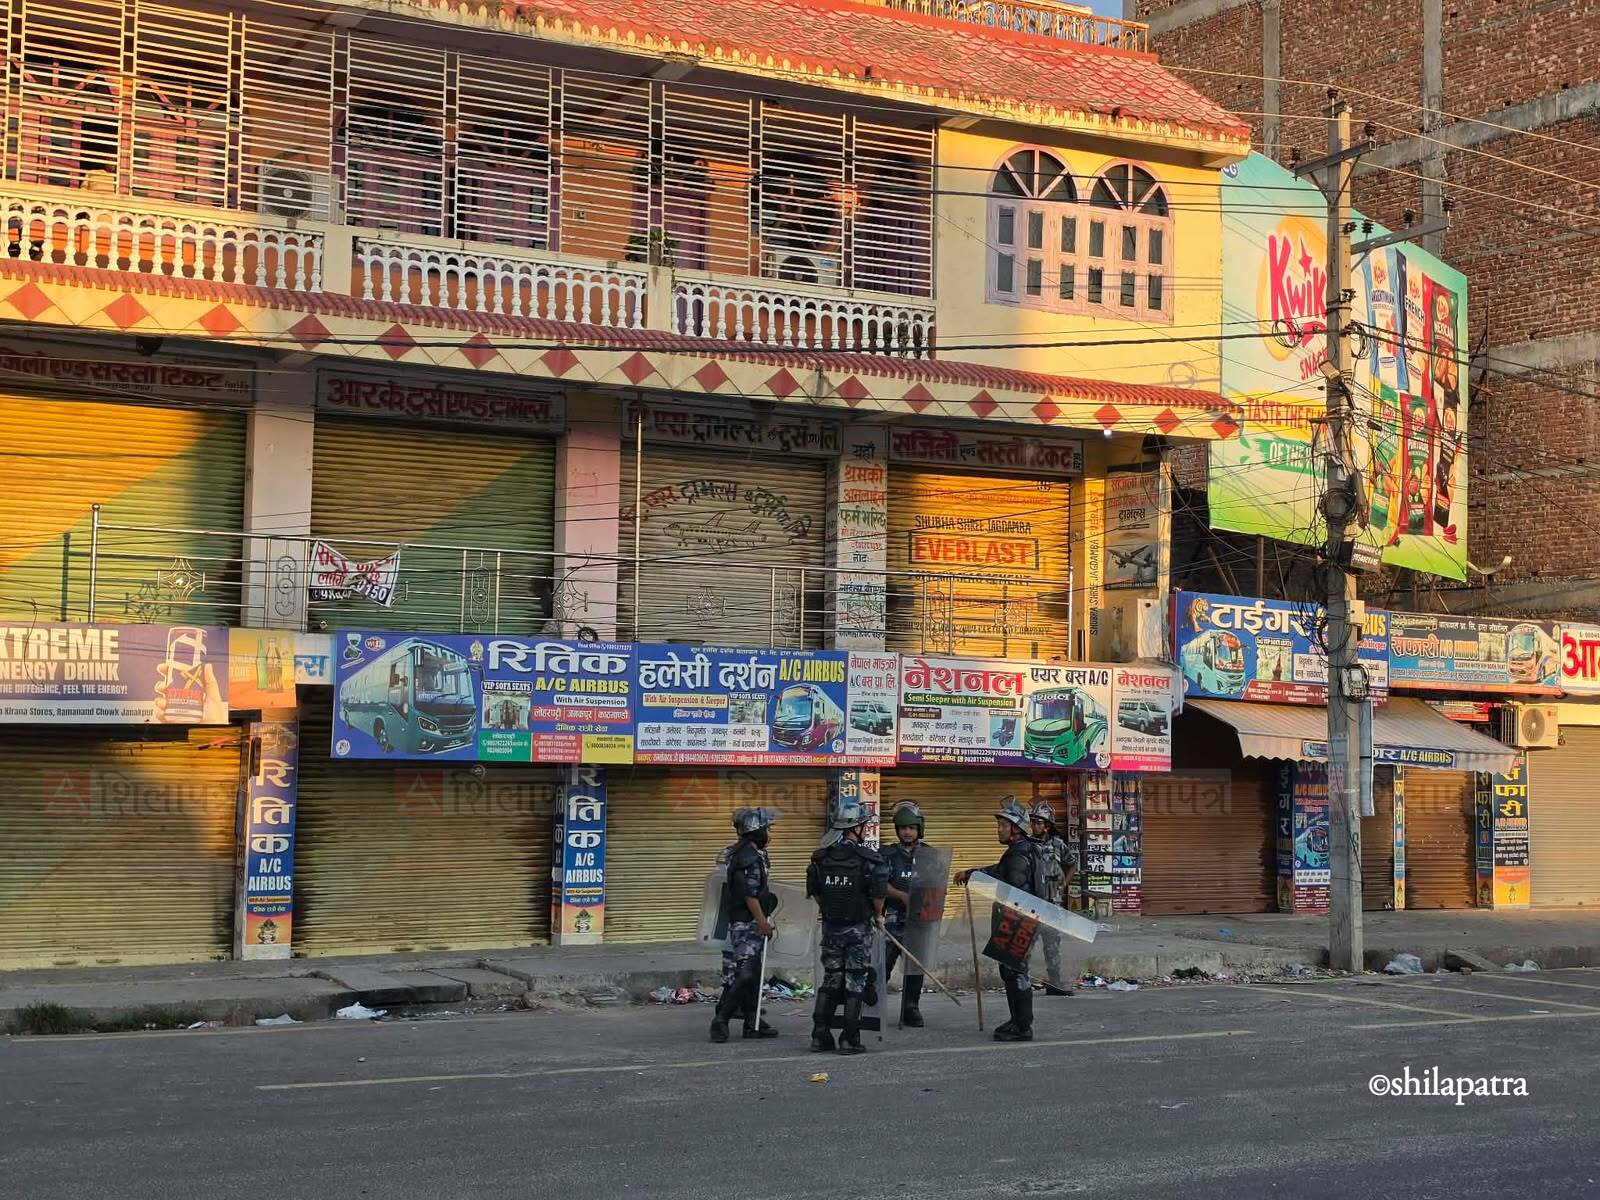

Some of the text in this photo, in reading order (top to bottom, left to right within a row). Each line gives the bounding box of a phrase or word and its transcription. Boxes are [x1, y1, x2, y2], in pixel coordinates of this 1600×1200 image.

[915, 537, 1032, 565] EVERLAST
[1211, 600, 1313, 638] टाईगर
[488, 639, 632, 675] रितिक
[64, 661, 120, 682] DRINK
[638, 652, 846, 691] हलेसी दर्शन A/C AIRBUS
[904, 659, 1109, 697] नेशनल एयर बस A/C
[483, 681, 496, 690] VIP
[535, 677, 629, 695] A/C AIRBUS
[1116, 671, 1172, 689] नेशनल
[14, 684, 62, 696] DIFFERENCE,
[62, 684, 81, 695] FEEL
[81, 684, 97, 695] THE
[97, 684, 129, 696] ENERGY!
[555, 696, 625, 708] With Air Suspension
[907, 693, 1014, 709] Semi Sleeper with Air Suspension
[95, 707, 120, 717] Chowk
[1400, 750, 1452, 766] A/C AIRBUS
[258, 858, 282, 874] A/C
[575, 852, 595, 867] A/C
[248, 875, 292, 892] AIRBUS
[565, 869, 604, 885] AIRBUS
[825, 875, 853, 887] A.P.F.
